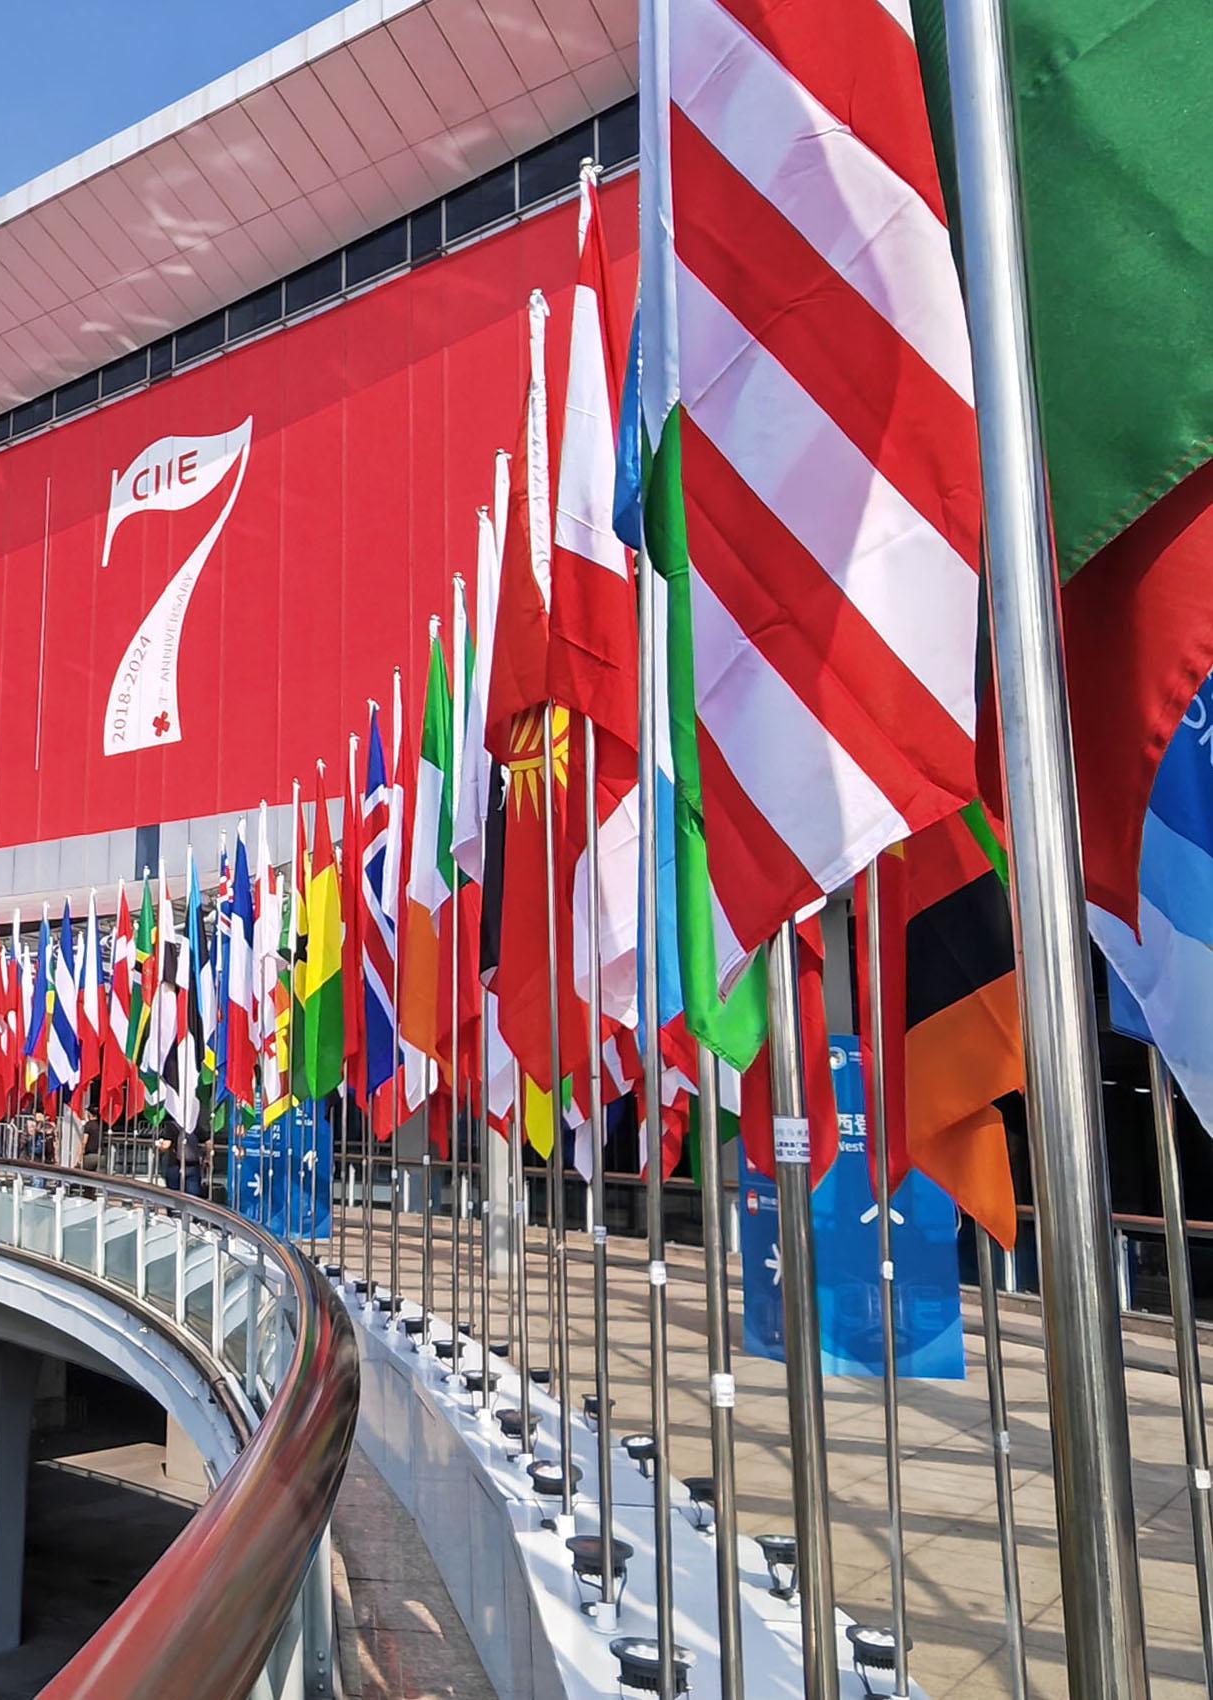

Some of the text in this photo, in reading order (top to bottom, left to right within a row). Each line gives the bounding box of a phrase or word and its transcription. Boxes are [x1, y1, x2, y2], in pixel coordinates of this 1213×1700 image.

[132, 449, 199, 502] CIIE
[159, 572, 194, 683] ANNIVERSARY
[112, 634, 153, 743] 2018-2024
